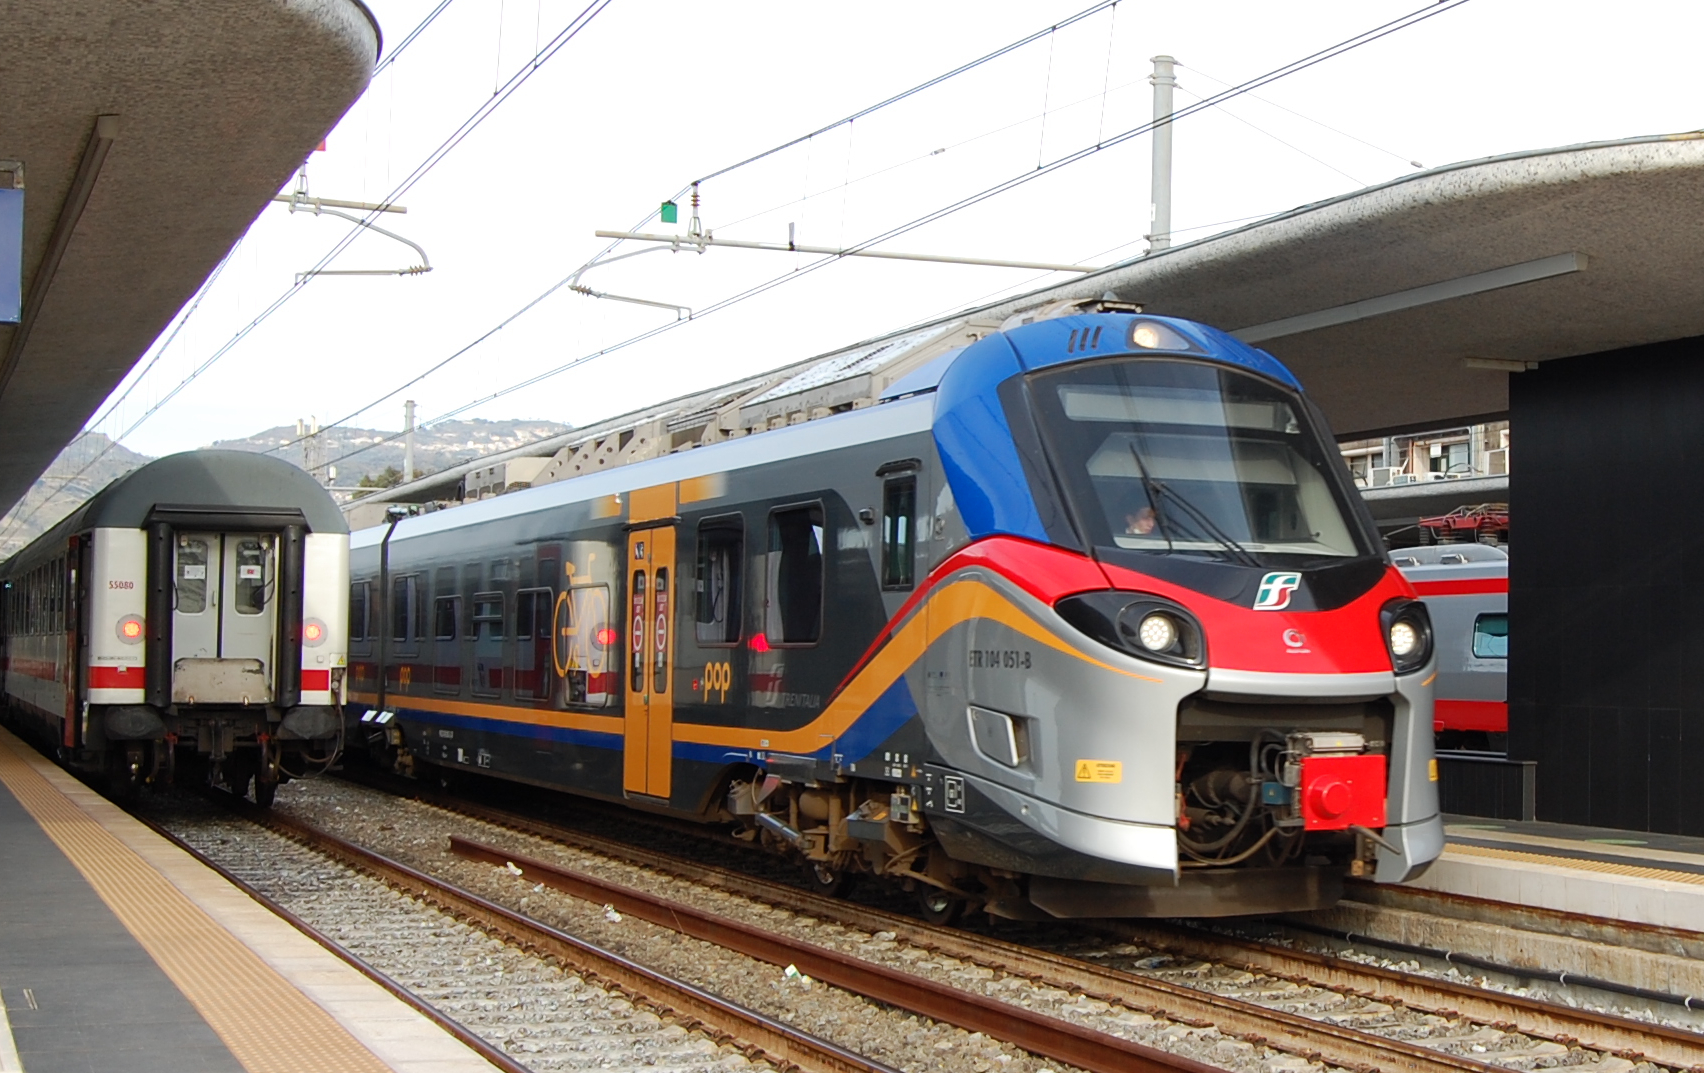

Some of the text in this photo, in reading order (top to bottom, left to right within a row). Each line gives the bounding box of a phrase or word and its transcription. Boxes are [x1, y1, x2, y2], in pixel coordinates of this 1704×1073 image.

[109, 580, 134, 590] 55080
[969, 650, 1032, 669] ETR 104 051-B
[704, 662, 731, 704] pop
[782, 692, 820, 709] TRENITALIA
